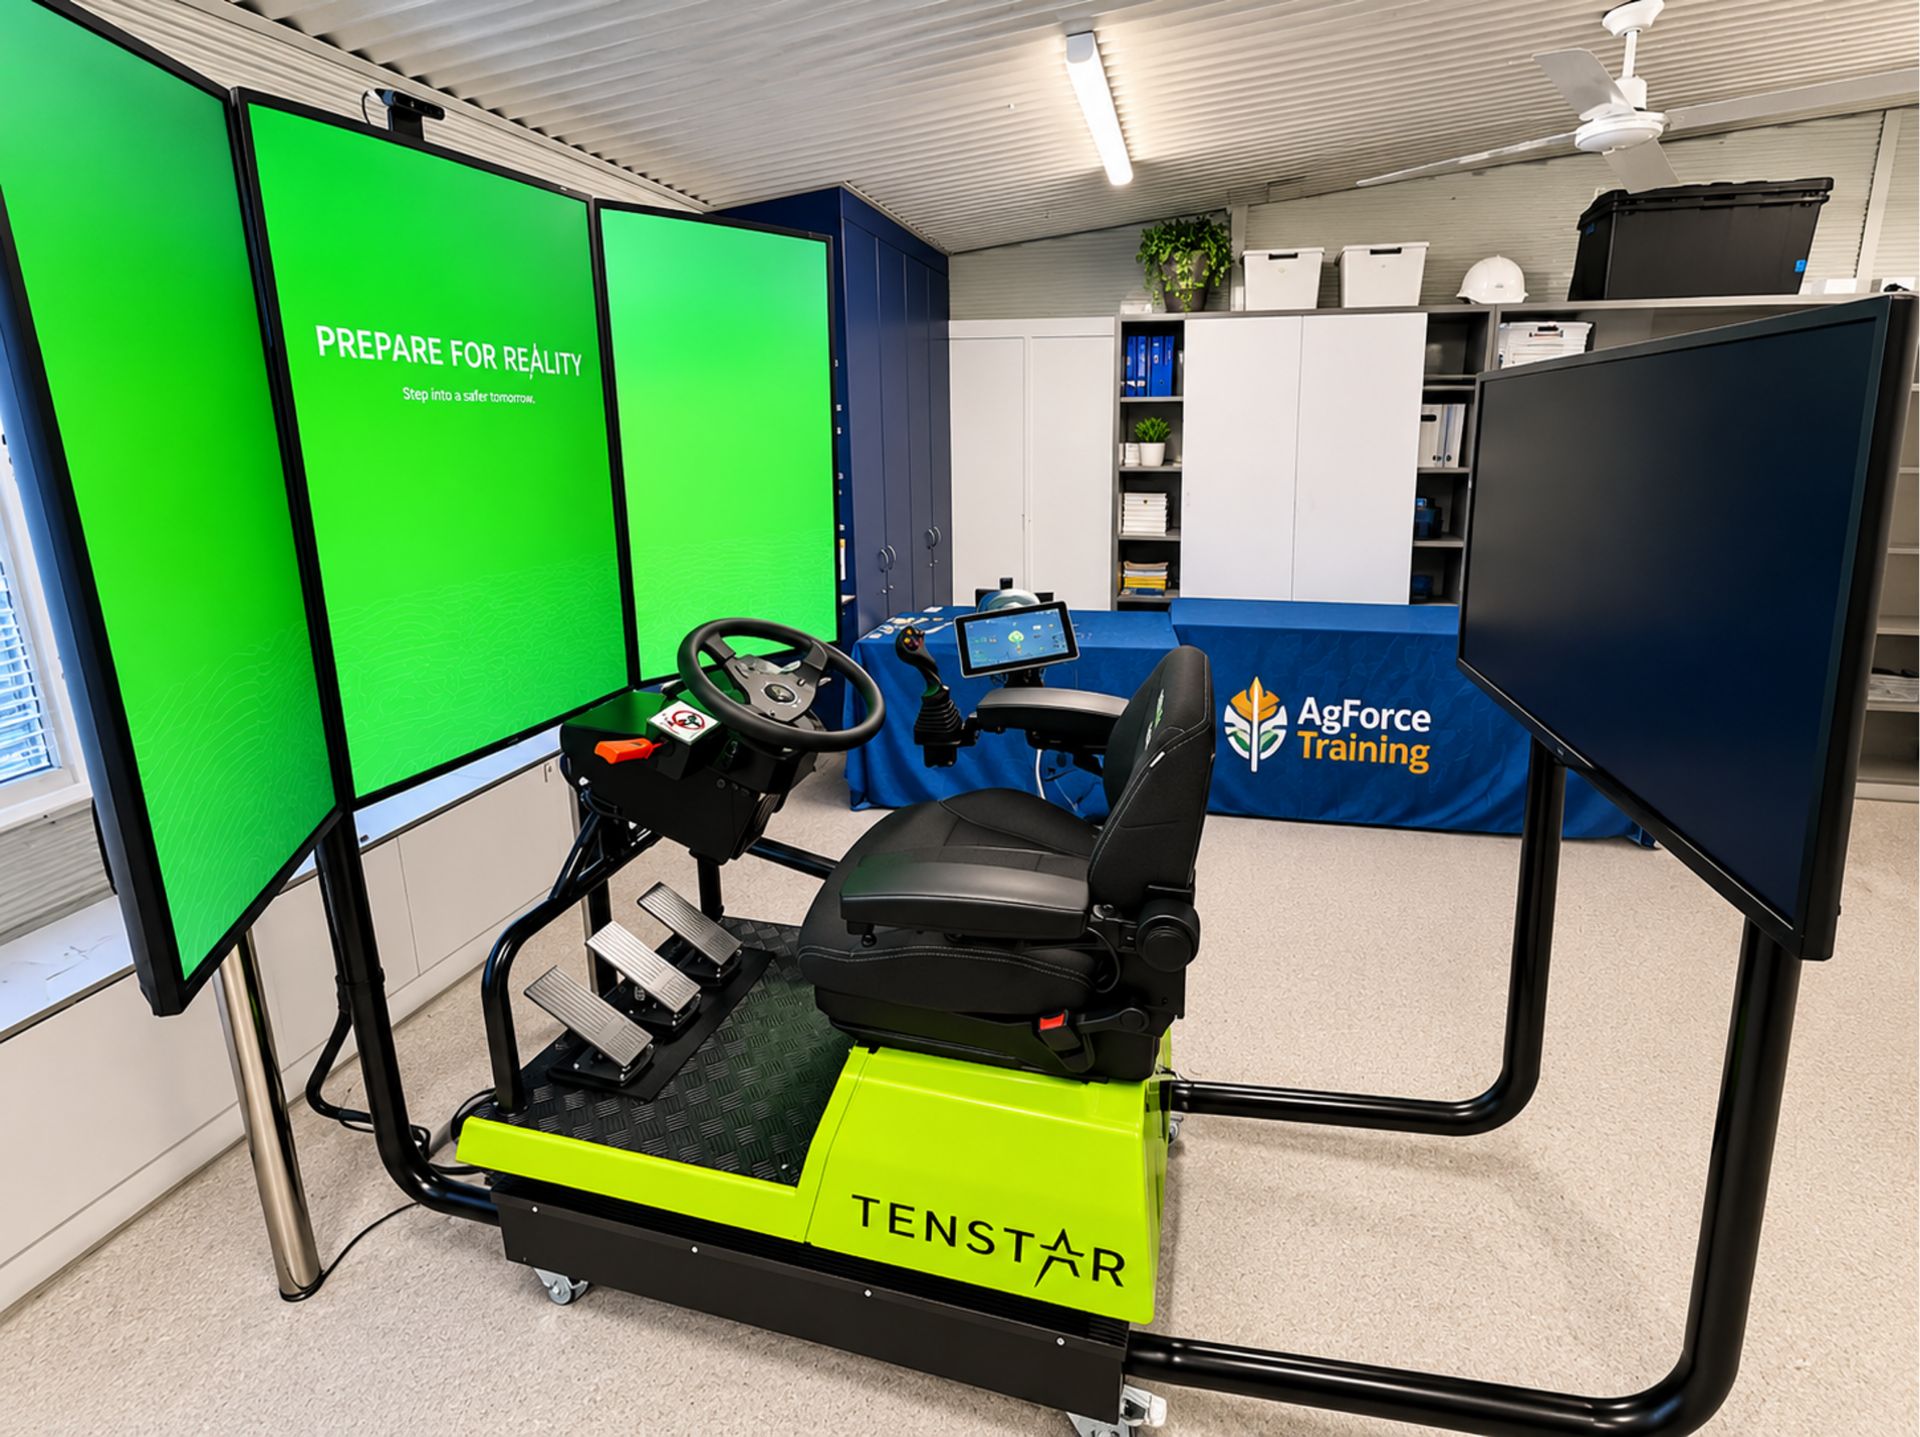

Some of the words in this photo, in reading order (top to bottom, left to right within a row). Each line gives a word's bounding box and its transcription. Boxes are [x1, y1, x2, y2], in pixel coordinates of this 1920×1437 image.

[315, 324, 444, 365] PREPARE
[449, 340, 498, 370] FOR
[502, 343, 583, 380] REALITY
[402, 387, 429, 403] Step
[430, 388, 453, 402] into
[454, 391, 462, 402] a
[463, 389, 488, 402] safer
[490, 392, 536, 404] tomorrow.
[1297, 696, 1432, 734] AgForce
[1297, 730, 1430, 774] Training
[851, 1194, 1126, 1288] TENSTAR
